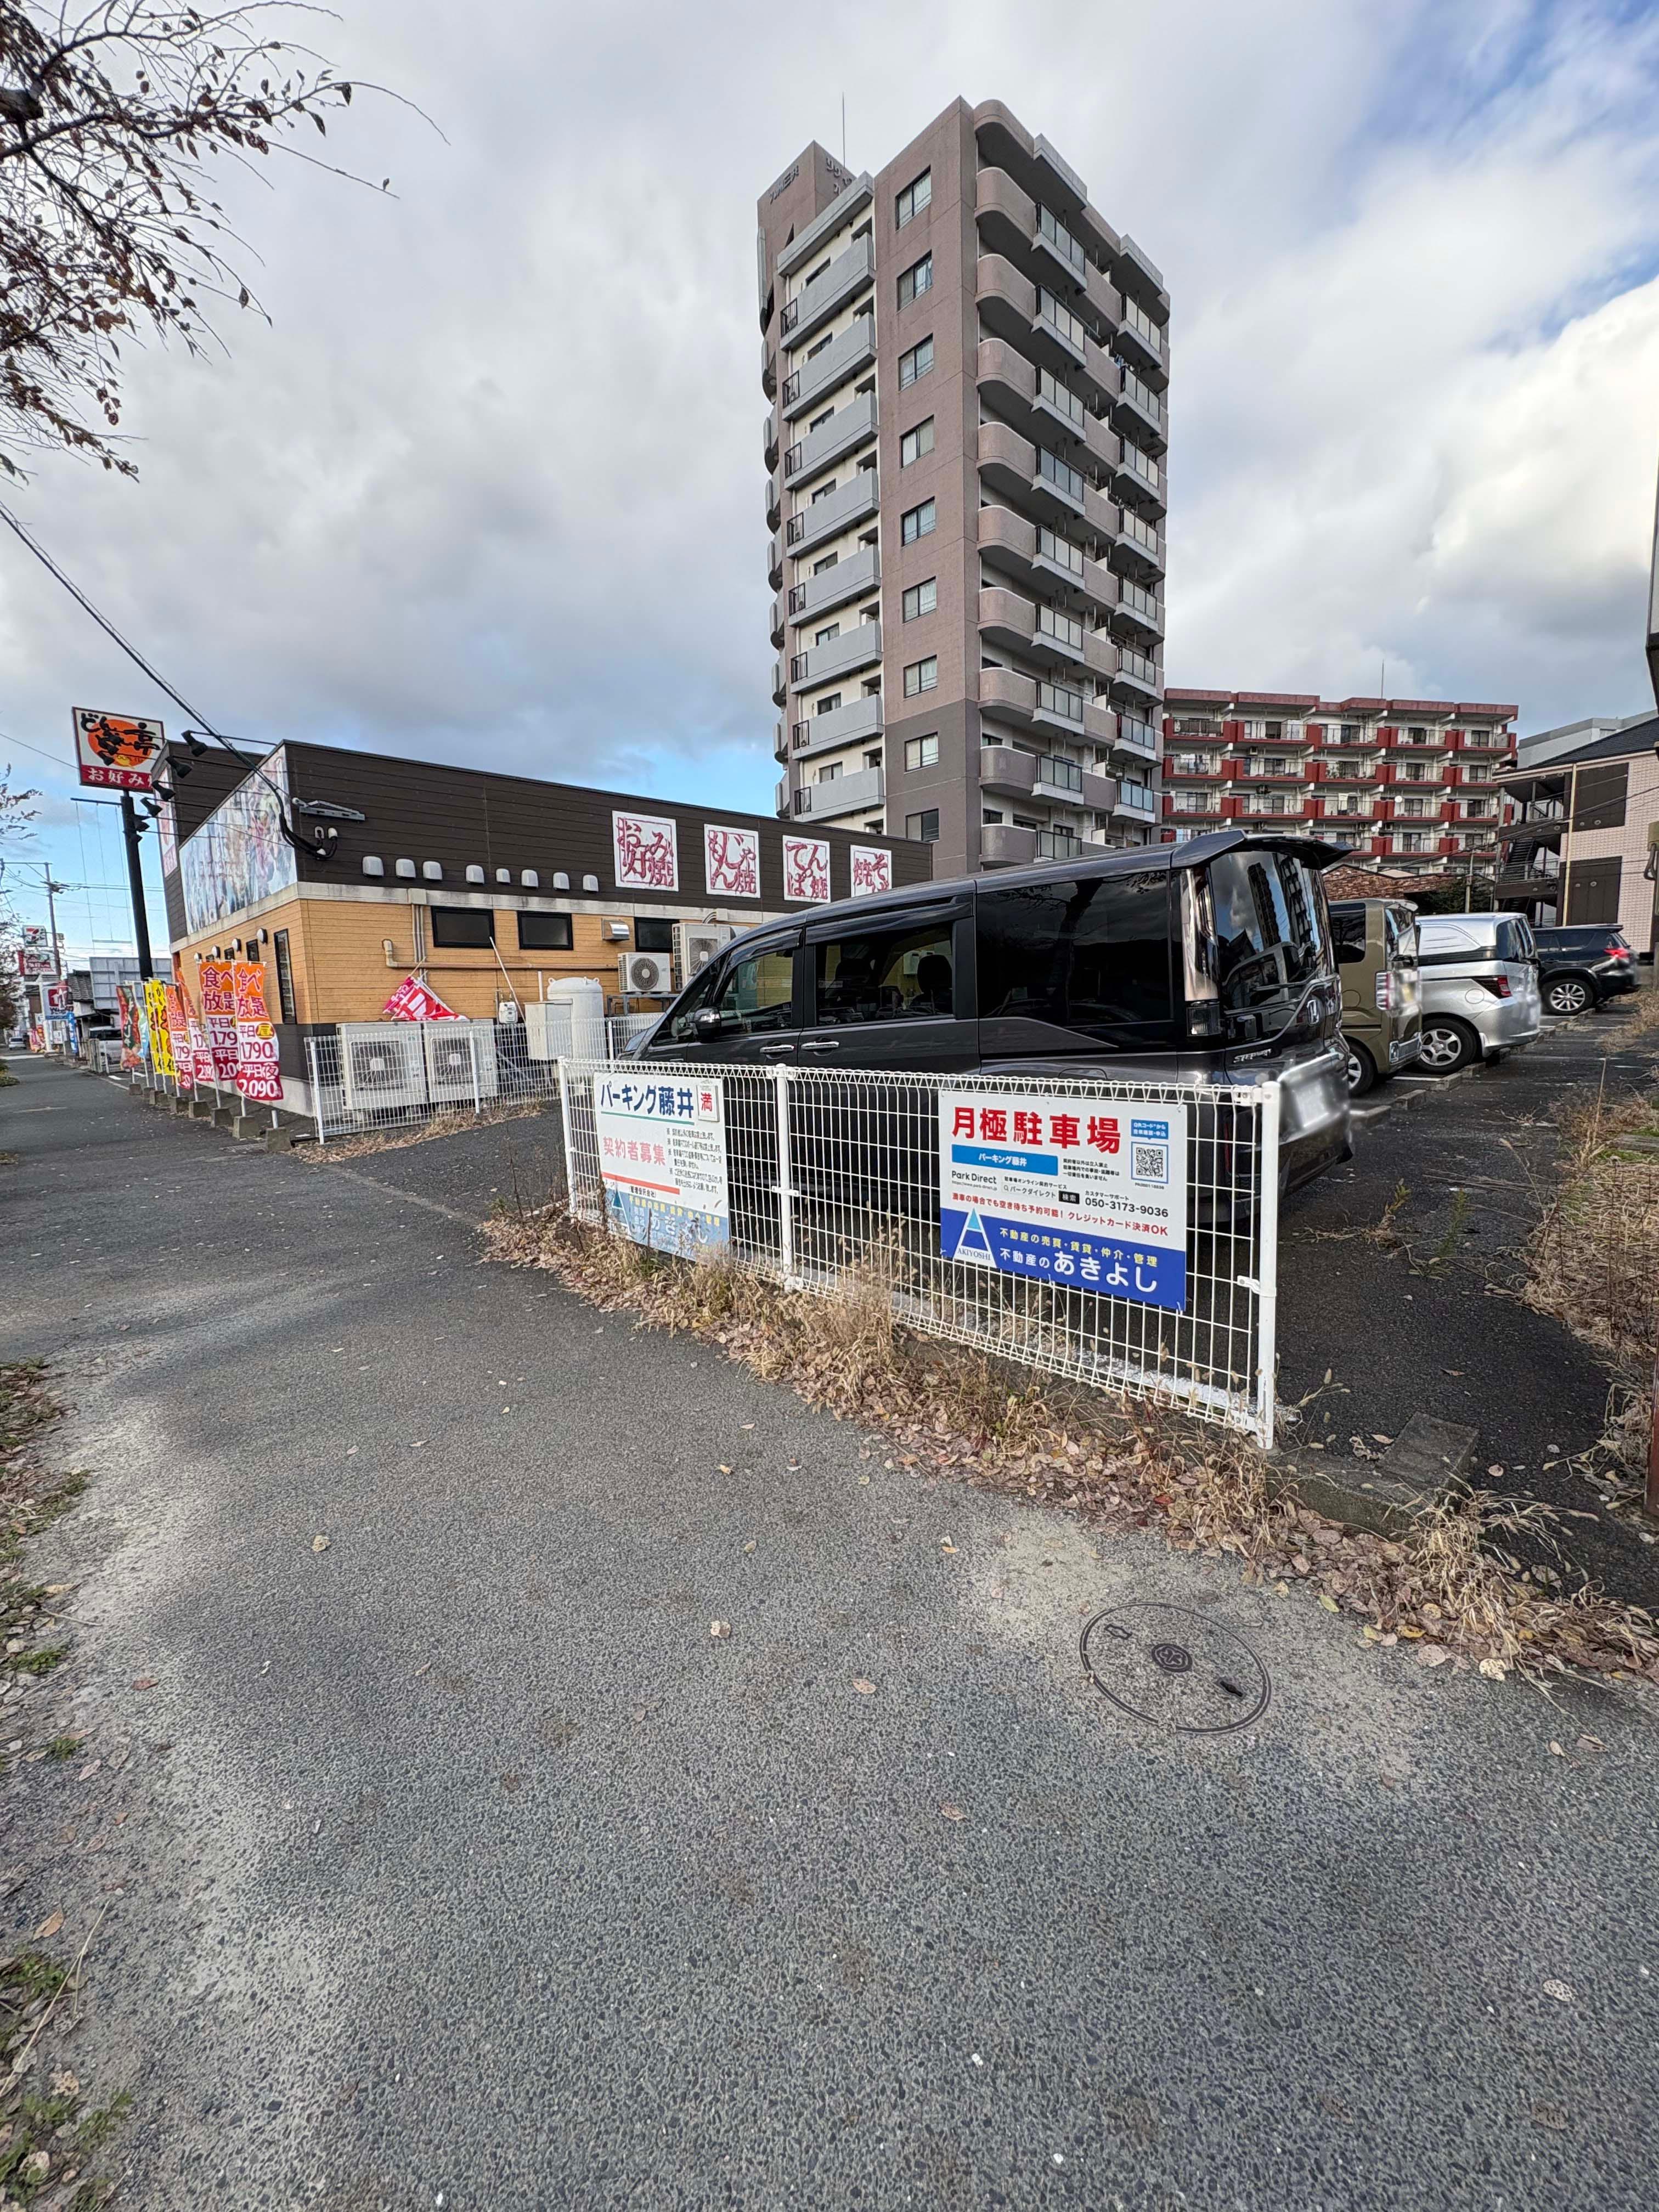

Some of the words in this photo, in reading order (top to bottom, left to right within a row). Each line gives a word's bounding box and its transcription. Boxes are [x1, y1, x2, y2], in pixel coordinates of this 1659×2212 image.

[88, 768, 152, 788] お好み
[210, 1016, 237, 1029] 平日
[215, 1048, 238, 1062] 平日
[601, 1081, 694, 1118] パーキング藤井
[701, 1092, 712, 1111] 満
[952, 1107, 1120, 1154] 月極駐車場
[603, 1136, 665, 1166] 契約者募集
[979, 1153, 1027, 1167] パーキング藤井
[952, 1171, 970, 1180] Park
[972, 1173, 997, 1184] Direct
[1010, 1186, 1056, 1199] パークダイレクト
[1062, 1193, 1076, 1202] 検索
[1085, 1190, 1129, 1201] カスタマーサポート
[1085, 1198, 1169, 1217] 050-3173-9036
[1068, 1211, 1168, 1236] クレジットカード決済OK
[957, 1247, 991, 1261] AKIYOSHI
[1000, 1227, 1158, 1267] 不動産の売買・賃貸・仲介・管理
[1000, 1248, 1157, 1292] 不動産のあきよし
